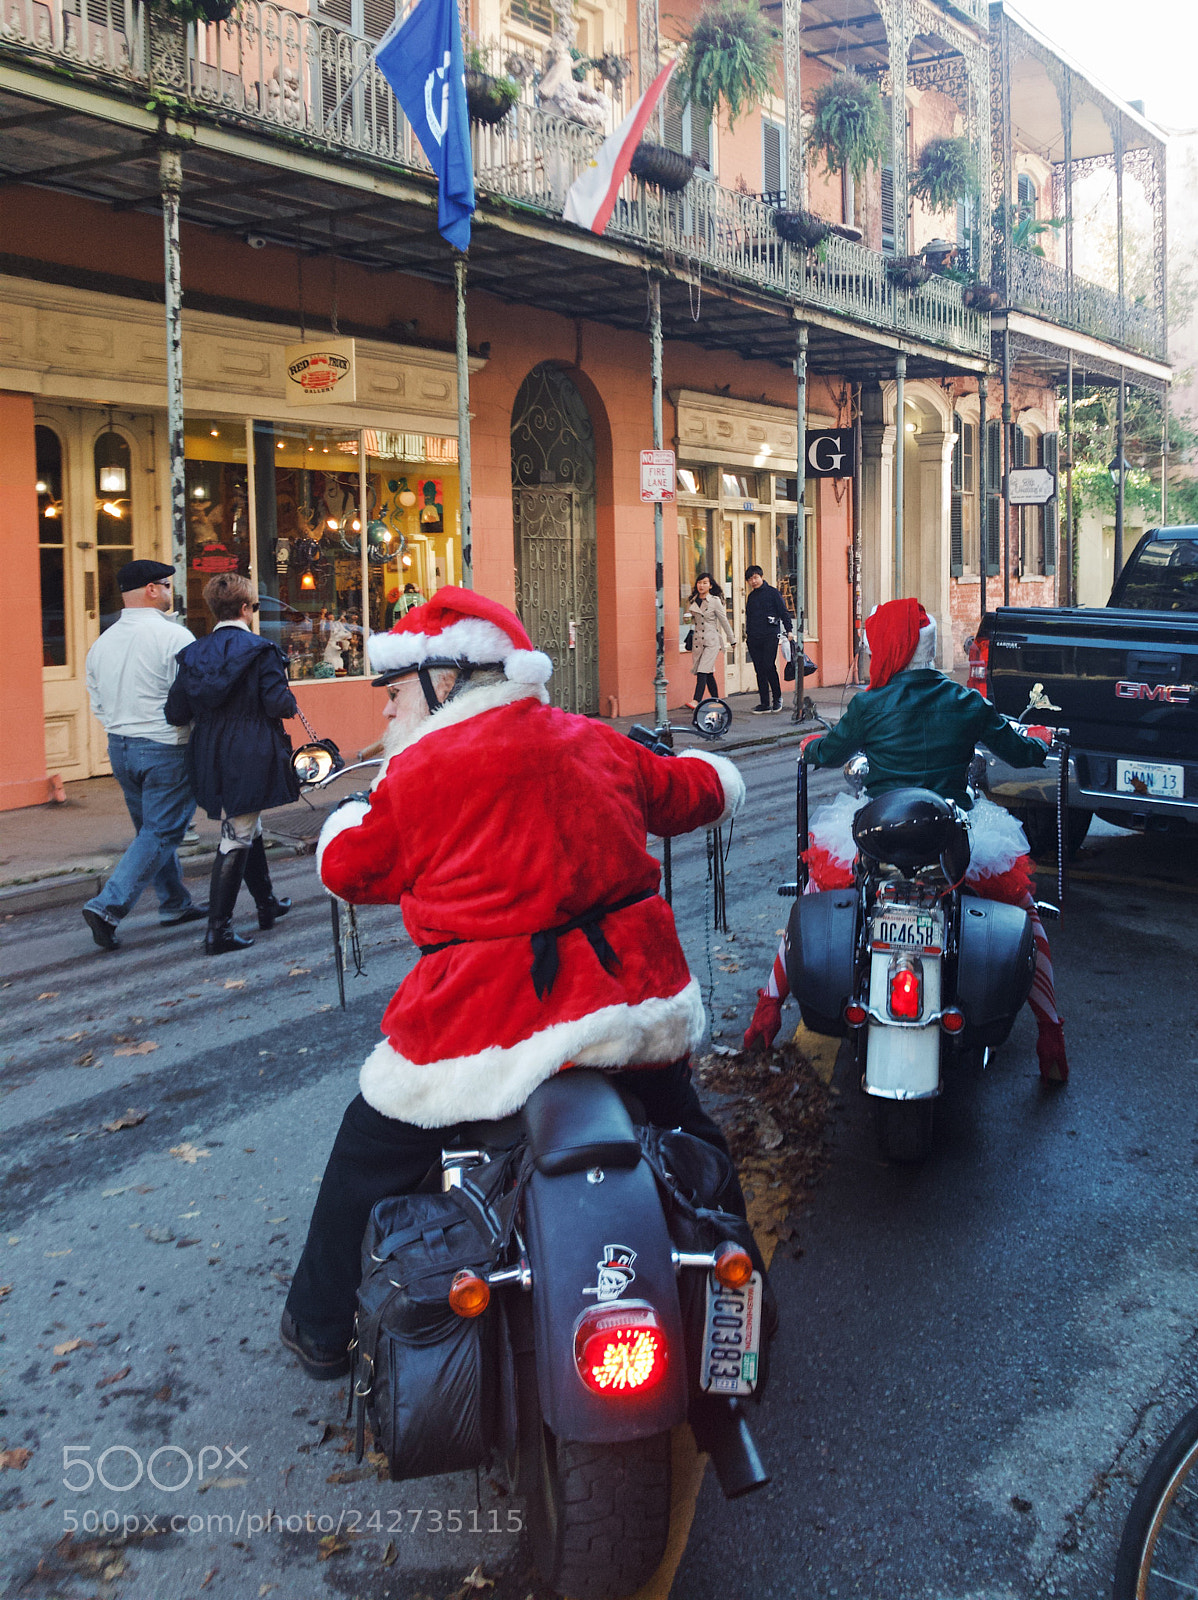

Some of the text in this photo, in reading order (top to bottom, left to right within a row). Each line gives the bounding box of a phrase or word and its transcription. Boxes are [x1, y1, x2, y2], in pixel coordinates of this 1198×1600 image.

[289, 356, 348, 376] RED TRUCK
[642, 452, 654, 464] NO
[808, 436, 847, 471] G
[649, 467, 667, 476] FIRE
[647, 478, 668, 487] LANE
[1115, 680, 1191, 704] GMC
[1161, 774, 1177, 790] 13
[745, 1286, 754, 1350] WASHINGTON
